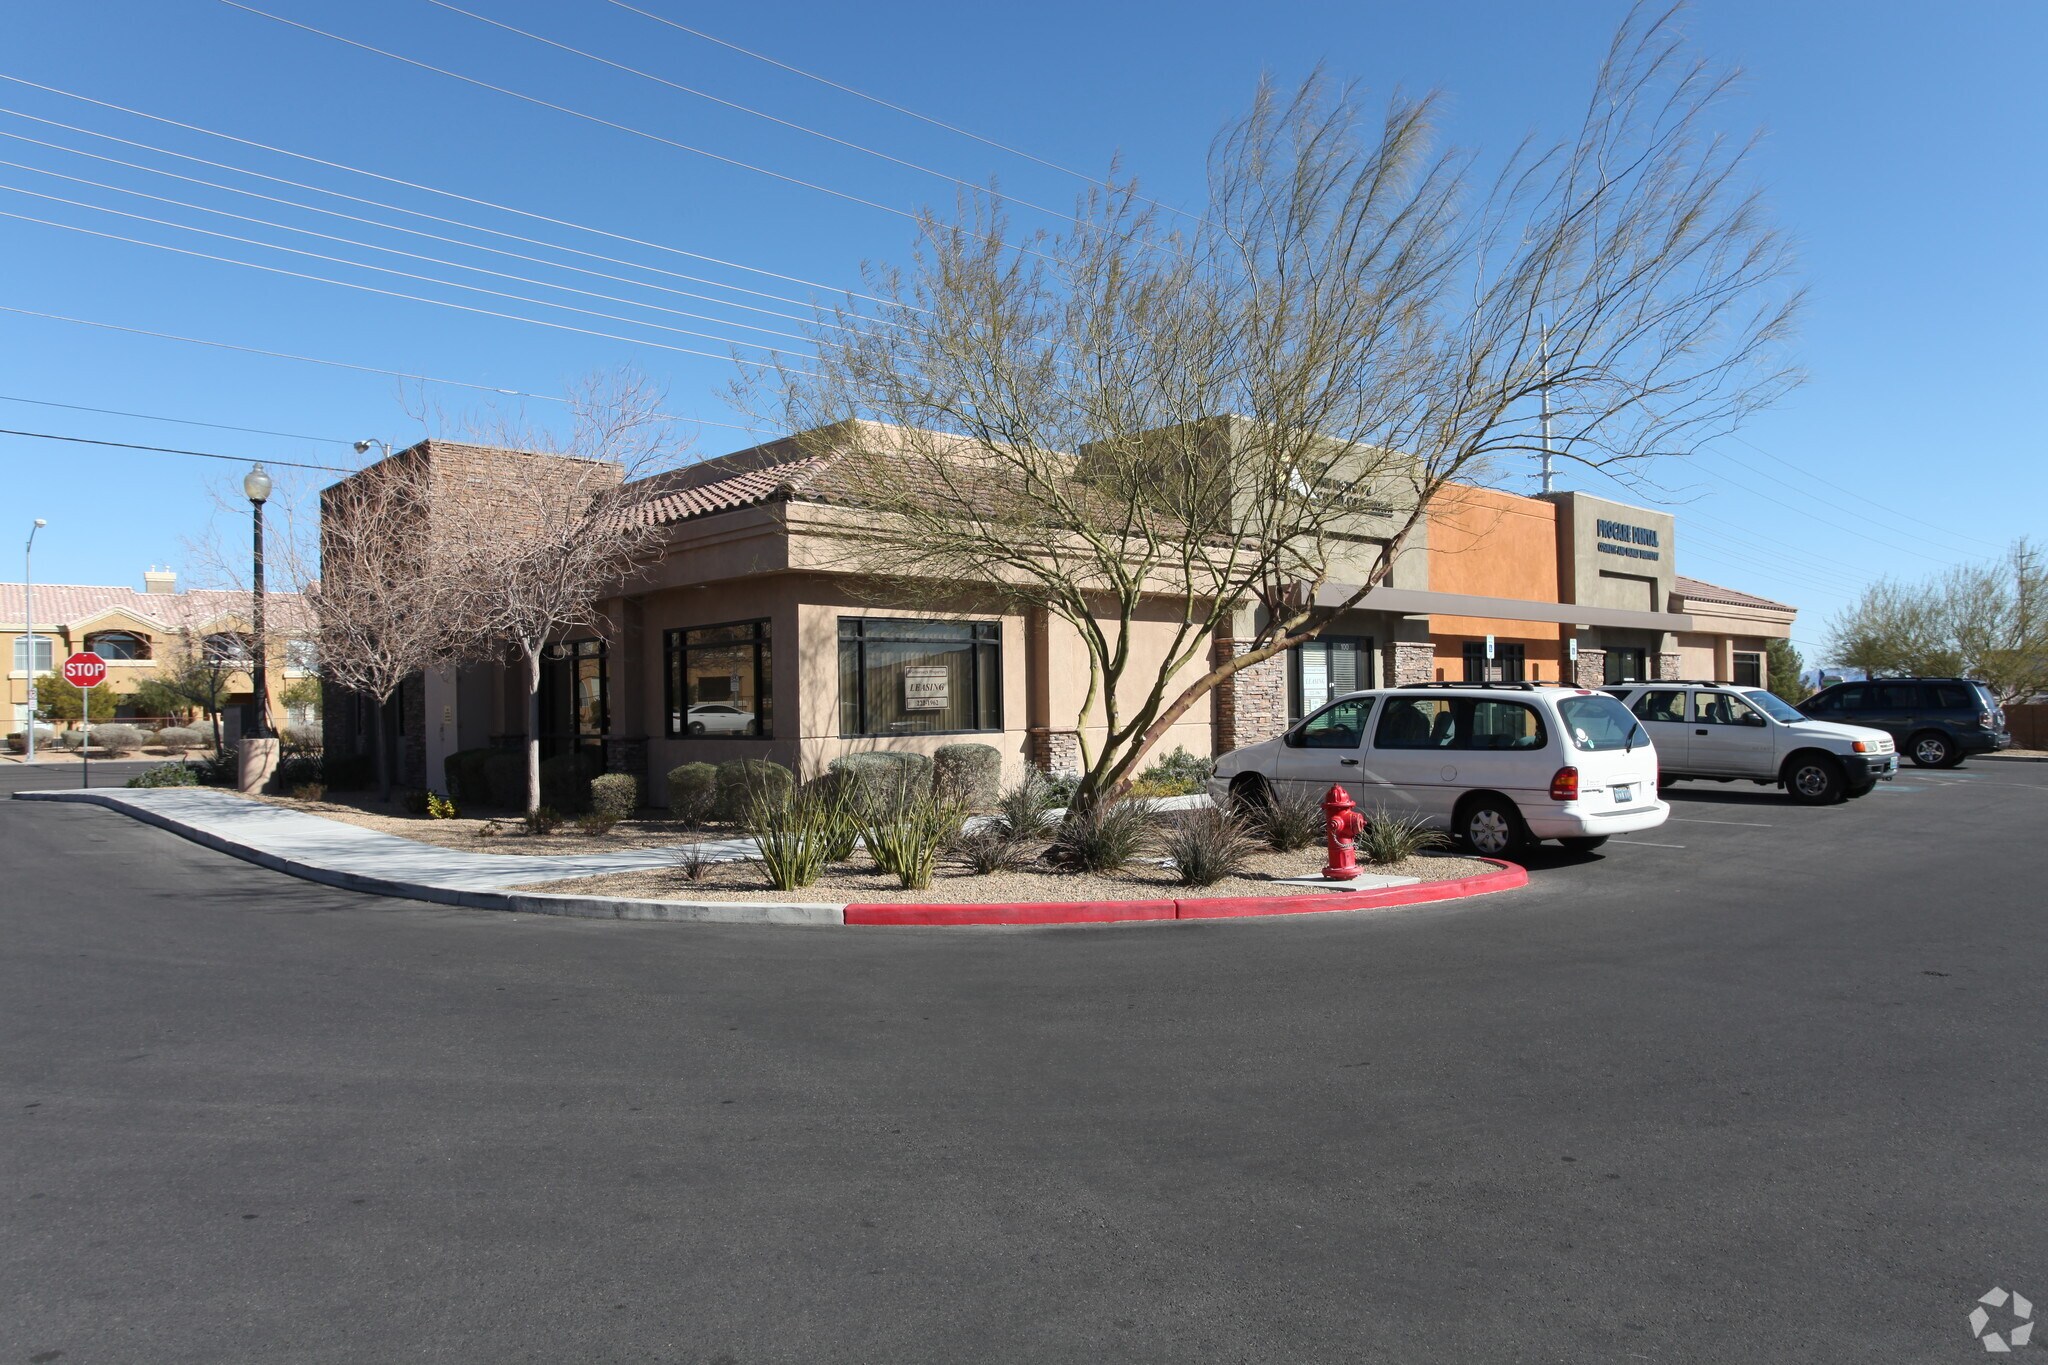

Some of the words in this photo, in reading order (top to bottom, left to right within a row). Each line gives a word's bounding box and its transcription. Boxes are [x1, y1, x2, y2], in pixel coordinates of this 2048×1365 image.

[1597, 519, 1632, 542] PROCARE
[1632, 526, 1659, 547] DENTAL
[66, 663, 104, 676] STOP
[909, 683, 945, 691] LEASING
